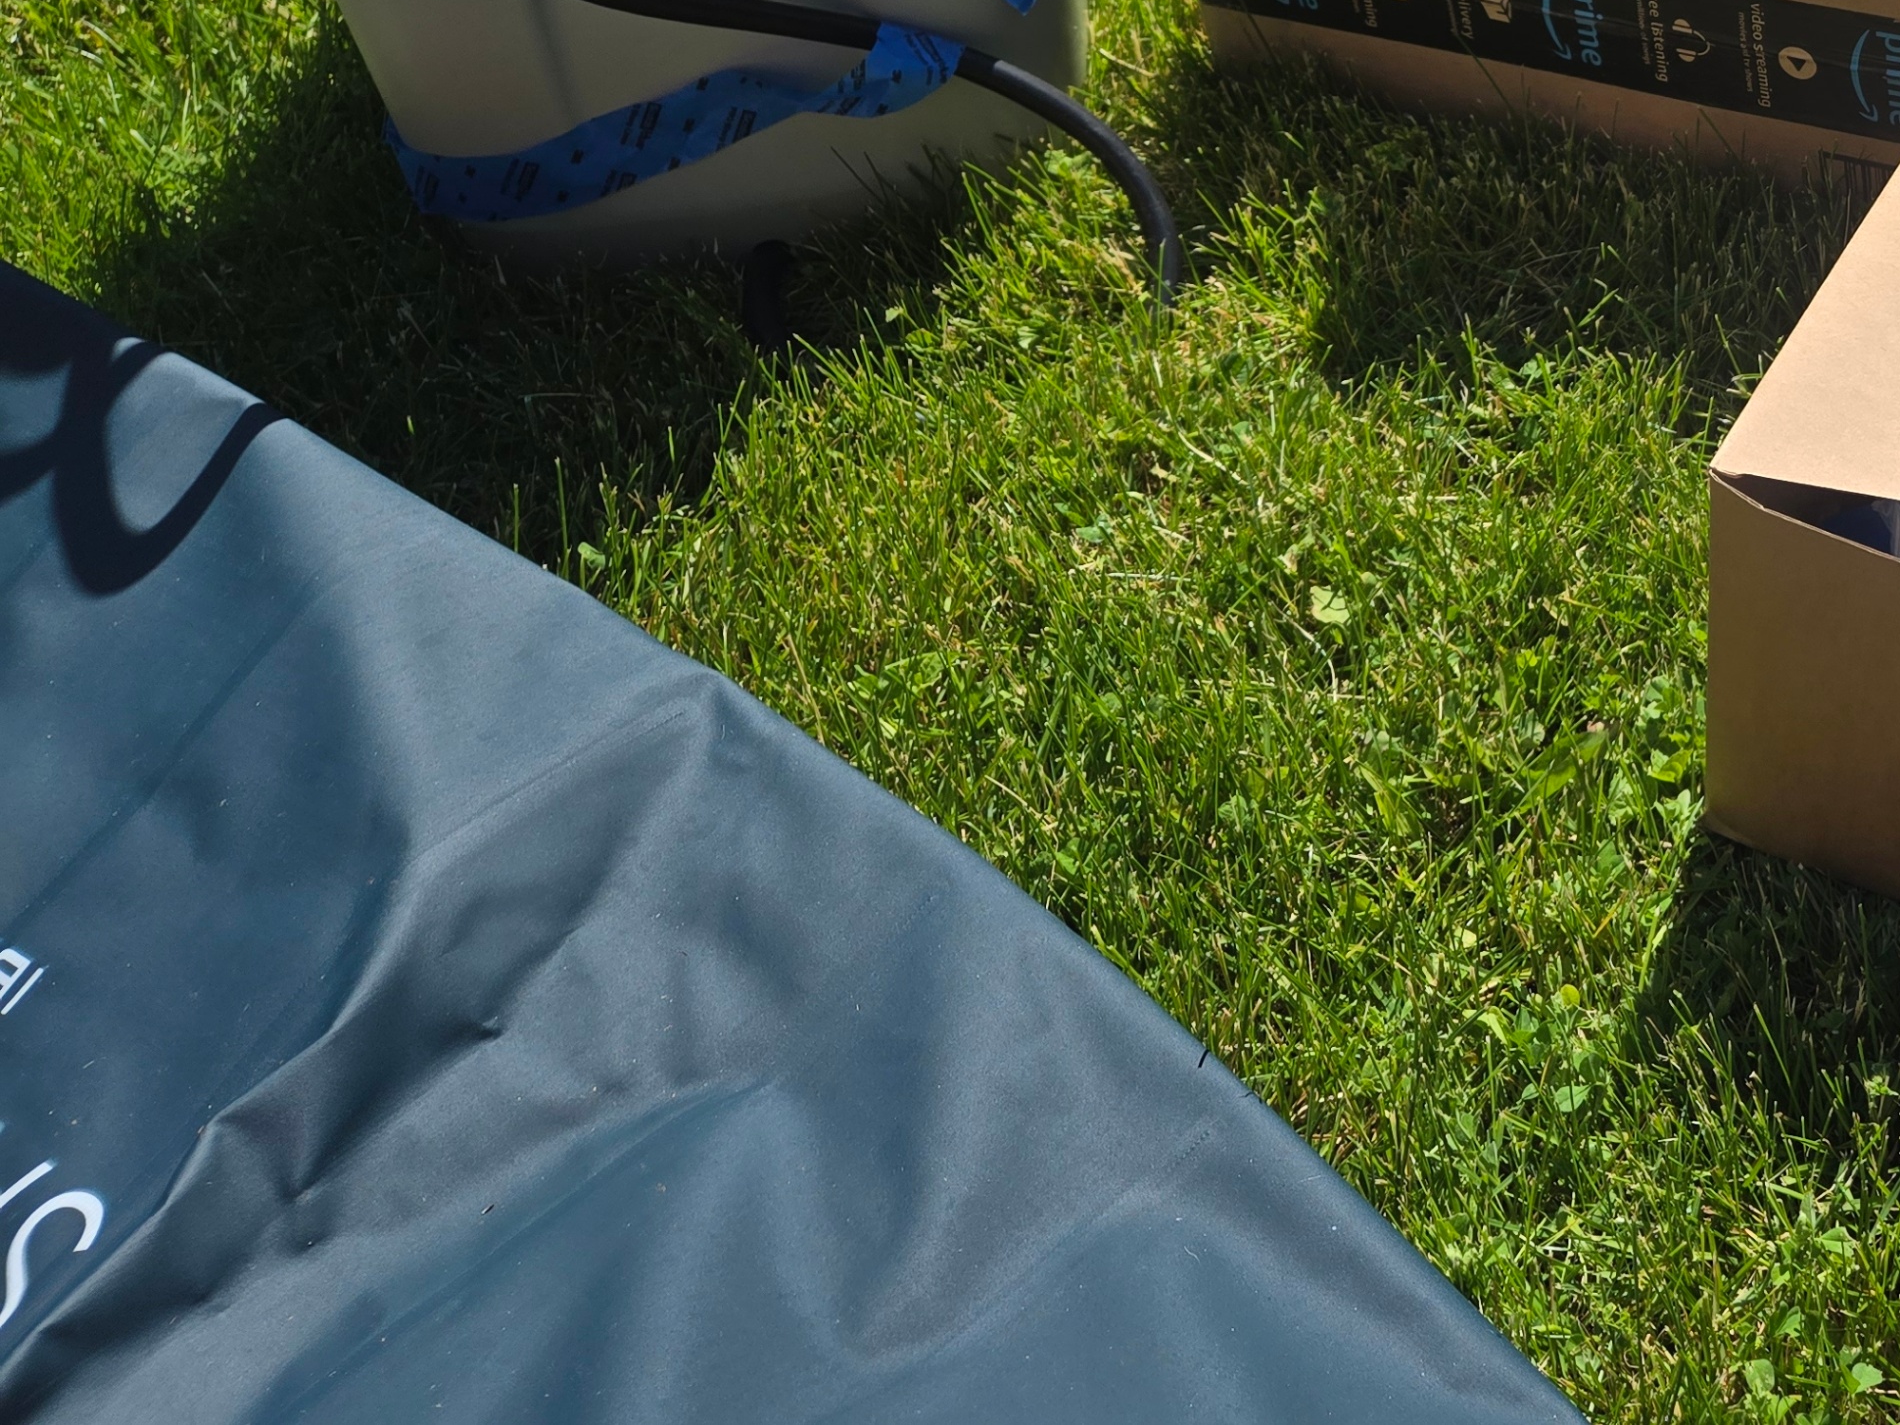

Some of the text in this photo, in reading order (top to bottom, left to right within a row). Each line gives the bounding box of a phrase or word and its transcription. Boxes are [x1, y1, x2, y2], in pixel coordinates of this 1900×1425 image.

[1736, 11, 1748, 42] movies
[1749, 2, 1763, 40] video
[1742, 59, 1750, 68] tv
[1743, 68, 1753, 93] shows
